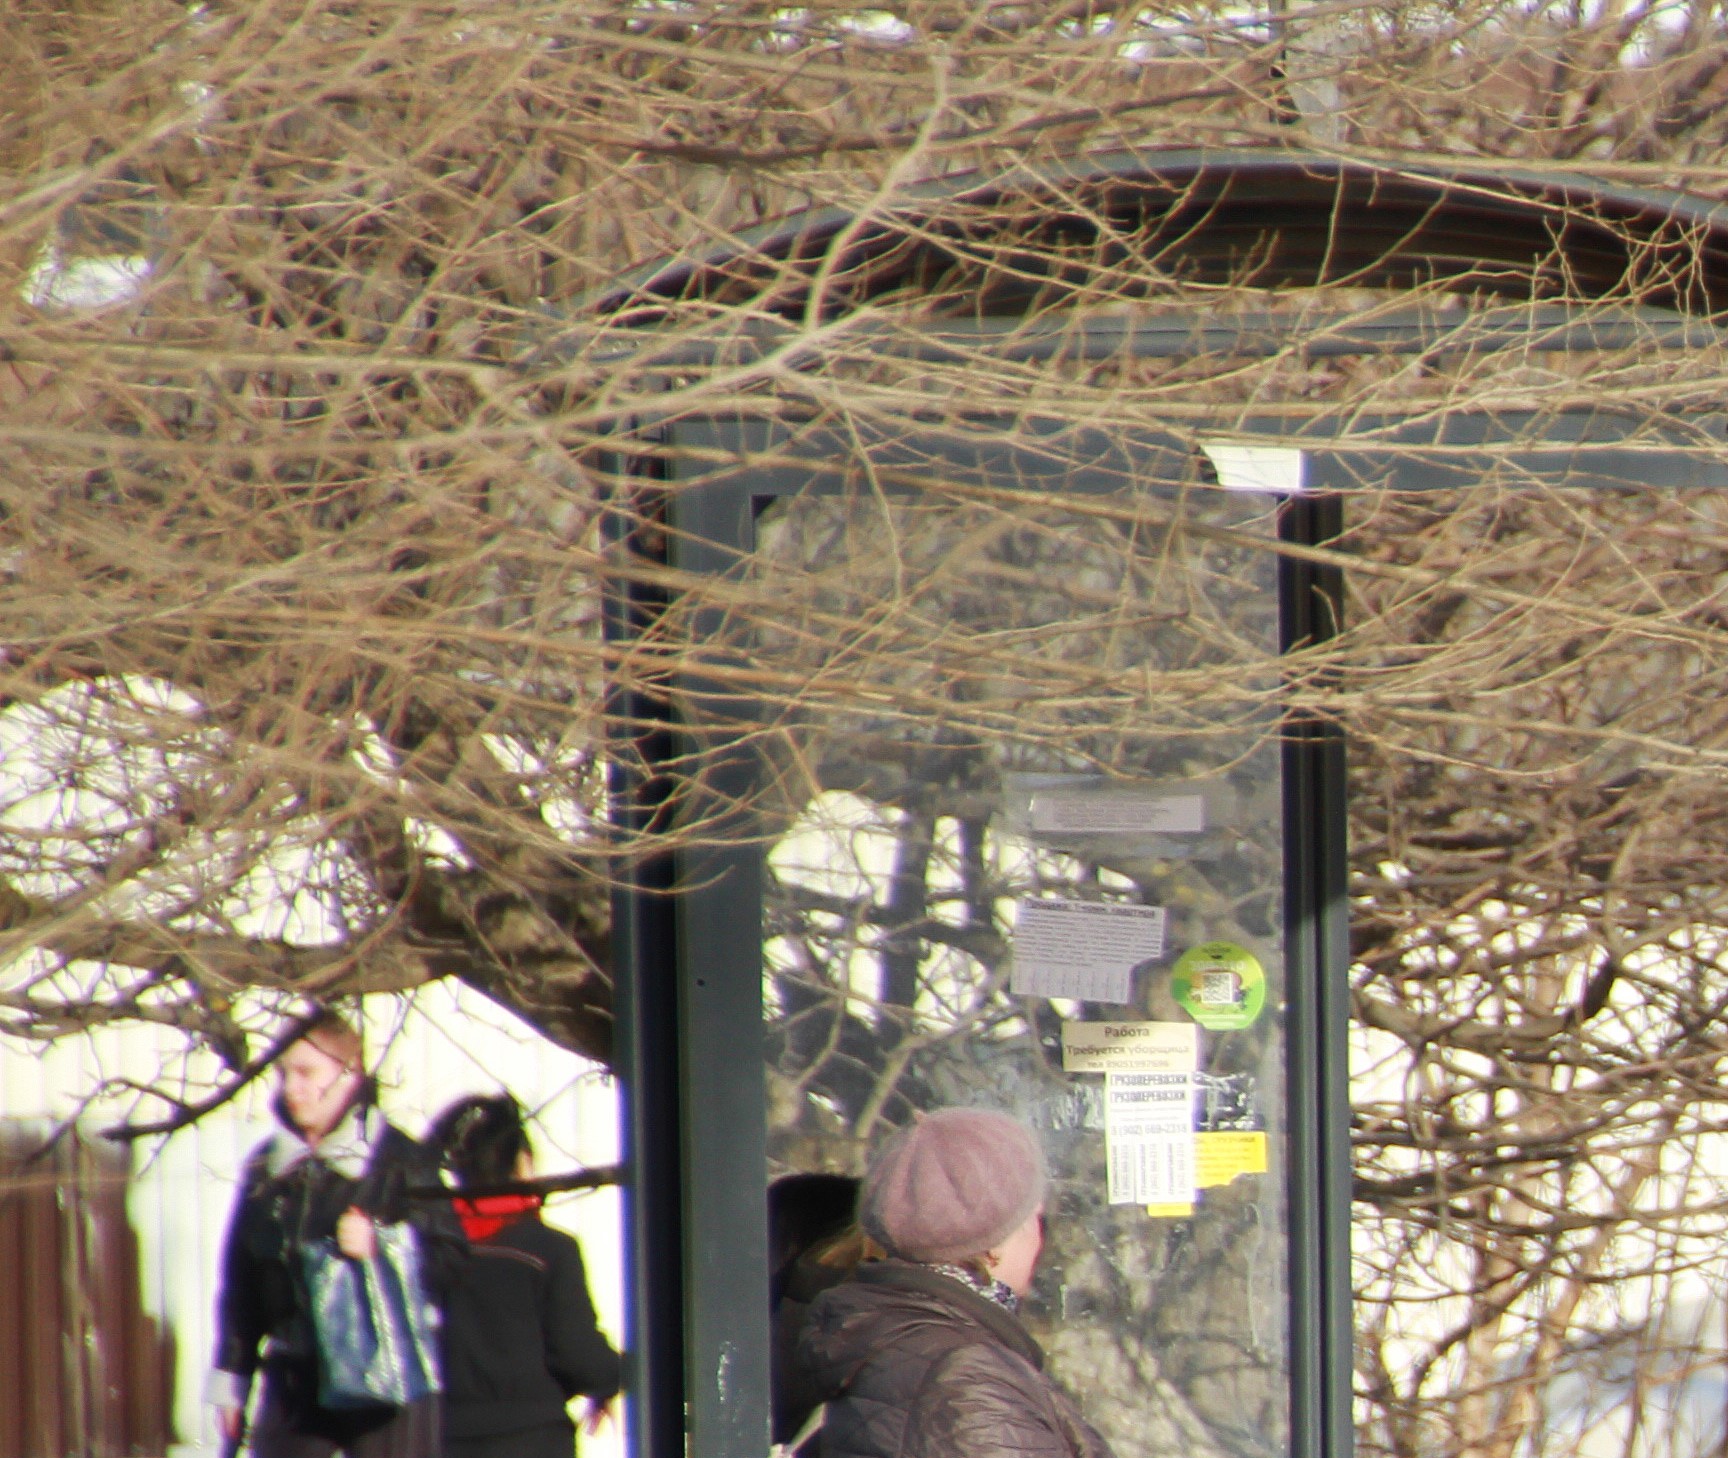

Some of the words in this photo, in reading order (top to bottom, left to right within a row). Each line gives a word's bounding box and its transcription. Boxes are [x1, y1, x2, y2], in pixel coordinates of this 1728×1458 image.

[1104, 1026, 1150, 1037] Работа
[1066, 1045, 1126, 1056] Требуется
[1128, 1043, 1189, 1055] уборщица
